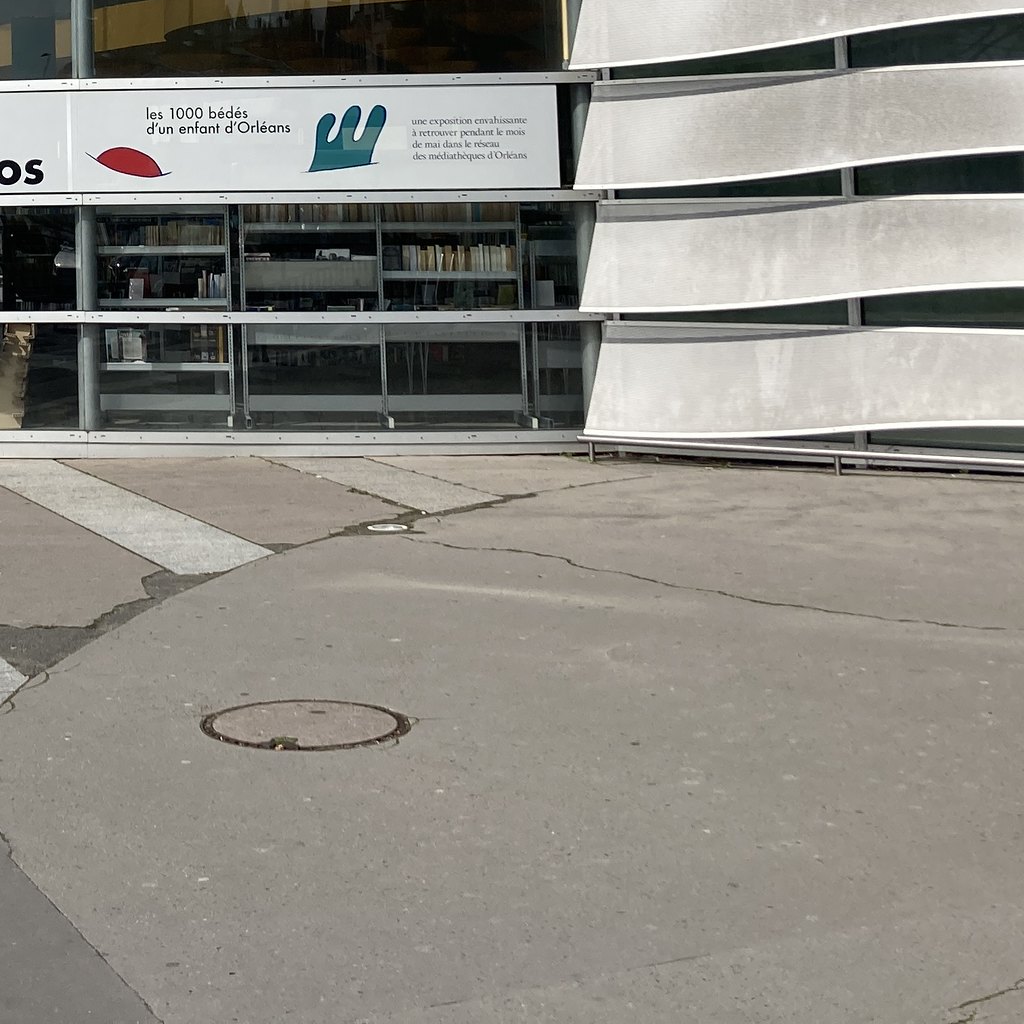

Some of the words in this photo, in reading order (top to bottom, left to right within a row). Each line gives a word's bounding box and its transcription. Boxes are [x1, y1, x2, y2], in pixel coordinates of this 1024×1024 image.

[146, 107, 163, 120] les
[169, 107, 203, 120] 1000
[208, 106, 248, 119] bédés
[146, 122, 173, 135] d'un
[179, 122, 220, 134] enfant
[224, 120, 291, 134] d'Orléans
[429, 116, 472, 127] exposition
[474, 116, 527, 125] envahissante
[411, 128, 417, 137] à
[419, 129, 457, 137] retrouver
[460, 127, 494, 139] pendant
[496, 127, 503, 136] le
[505, 127, 526, 136] mois
[412, 140, 422, 148] de
[424, 140, 441, 148] mai
[443, 139, 463, 148] dans
[464, 139, 472, 147] le
[474, 139, 500, 148] réseau
[412, 151, 426, 160] des
[428, 150, 486, 162] médiathèques
[487, 150, 527, 160] d'Orléans
